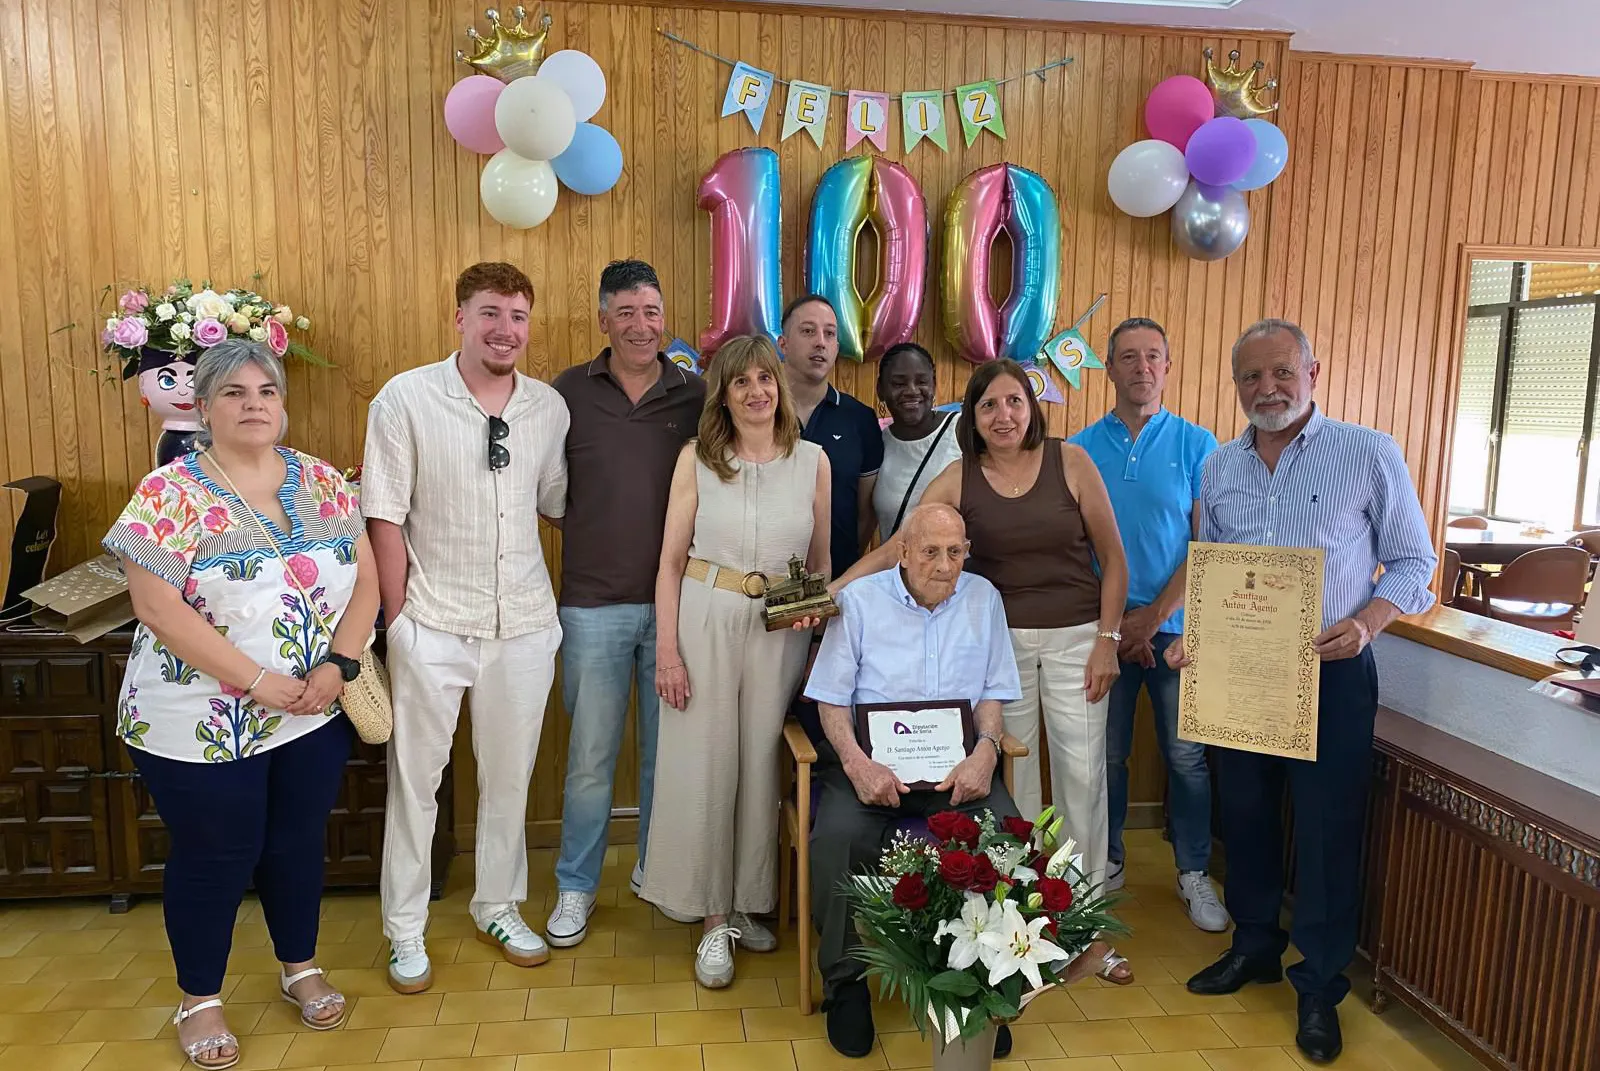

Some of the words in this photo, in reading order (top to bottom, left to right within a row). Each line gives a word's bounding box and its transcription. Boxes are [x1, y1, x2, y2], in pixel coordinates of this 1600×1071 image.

[738, 75, 992, 132] FELIZ
[696, 147, 1062, 365] 100
[1230, 589, 1268, 603] Santiago
[1221, 598, 1246, 609] Antón
[894, 745, 916, 754] Santiago
